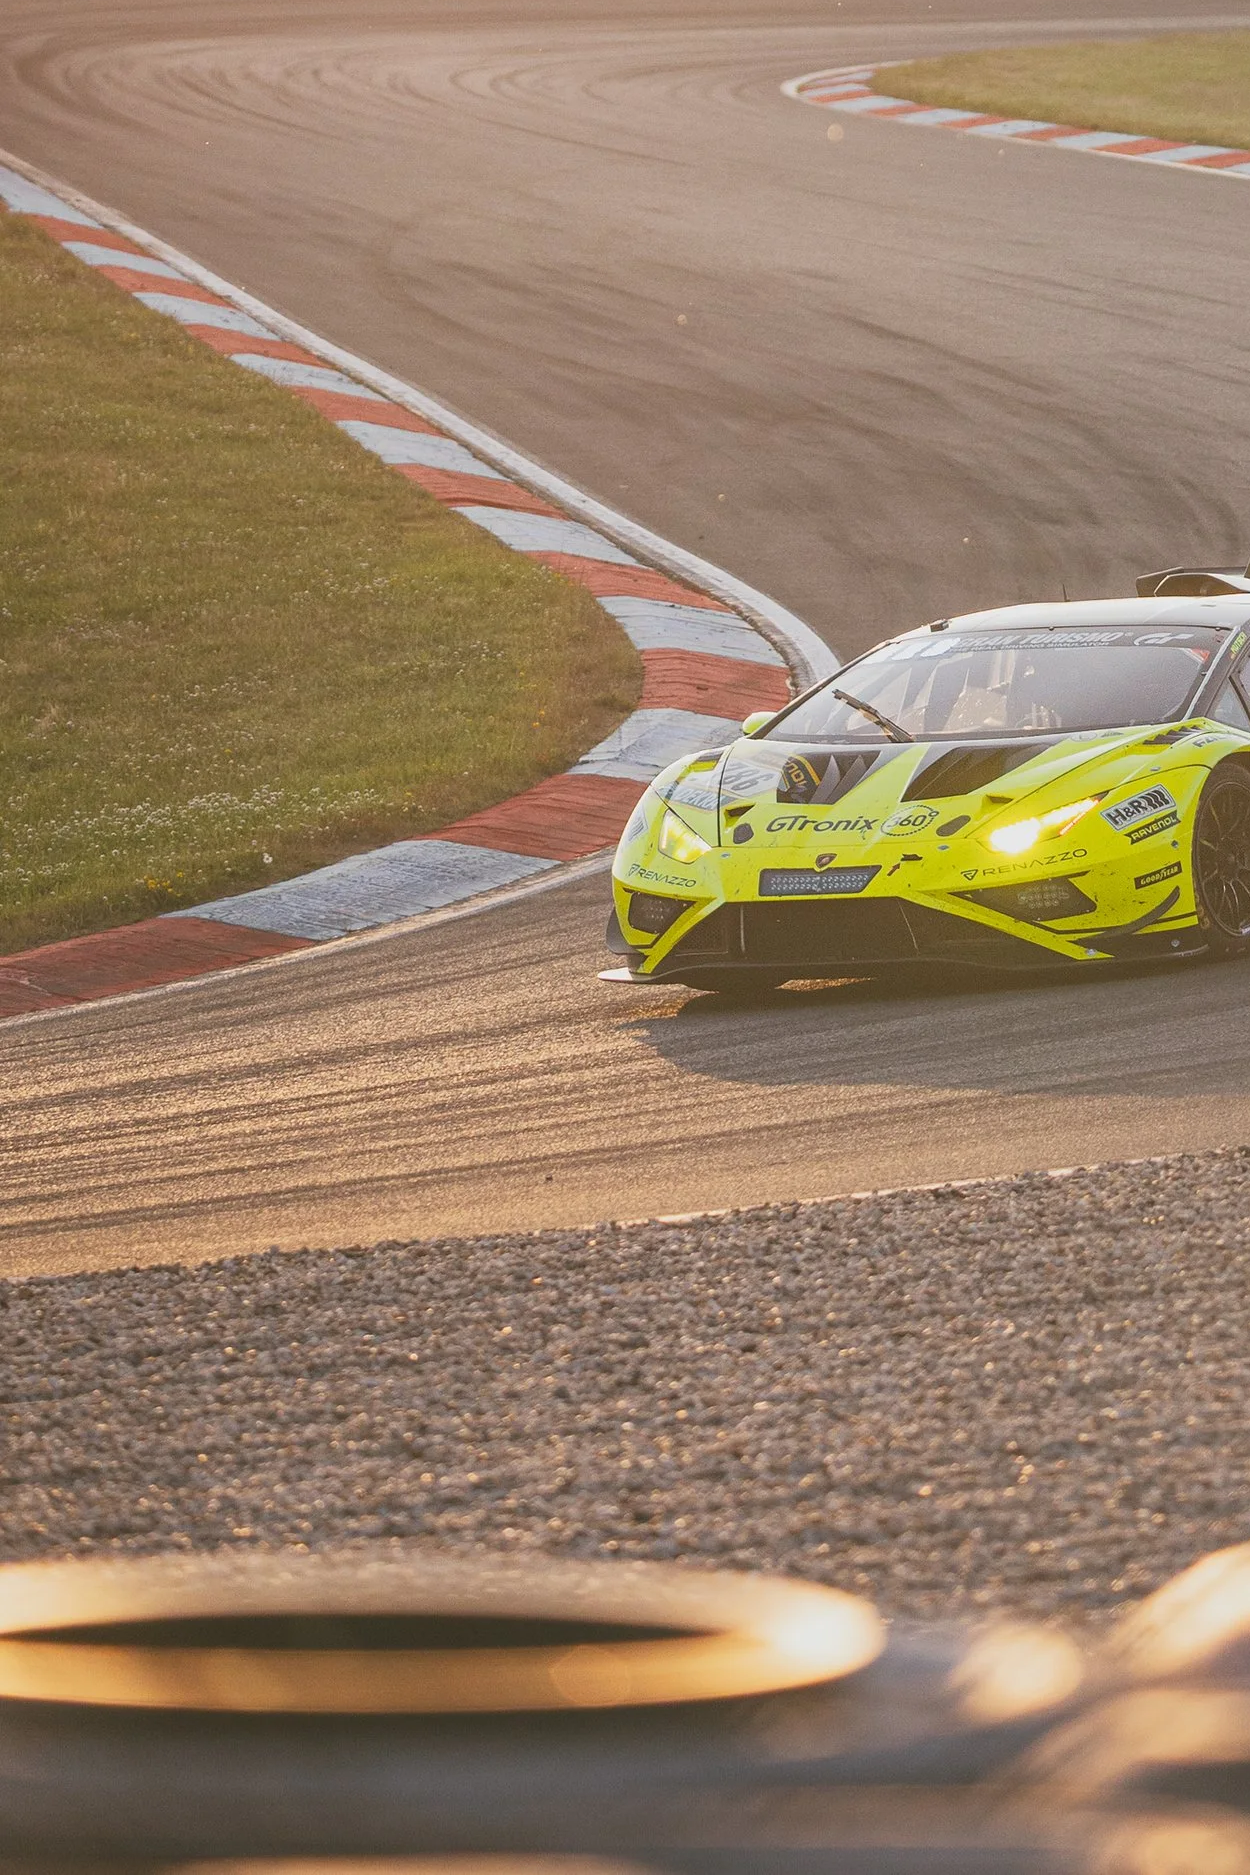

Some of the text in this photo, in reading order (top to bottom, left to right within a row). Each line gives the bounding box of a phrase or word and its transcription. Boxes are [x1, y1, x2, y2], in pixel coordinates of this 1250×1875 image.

[766, 815, 879, 832] GTronix
[1106, 798, 1148, 826] H&R
[1131, 815, 1177, 841] RAVENOL
[982, 848, 1088, 876] RENAZZO
[638, 868, 697, 888] RENAZZO
[1140, 865, 1179, 886] GOODYEAR
